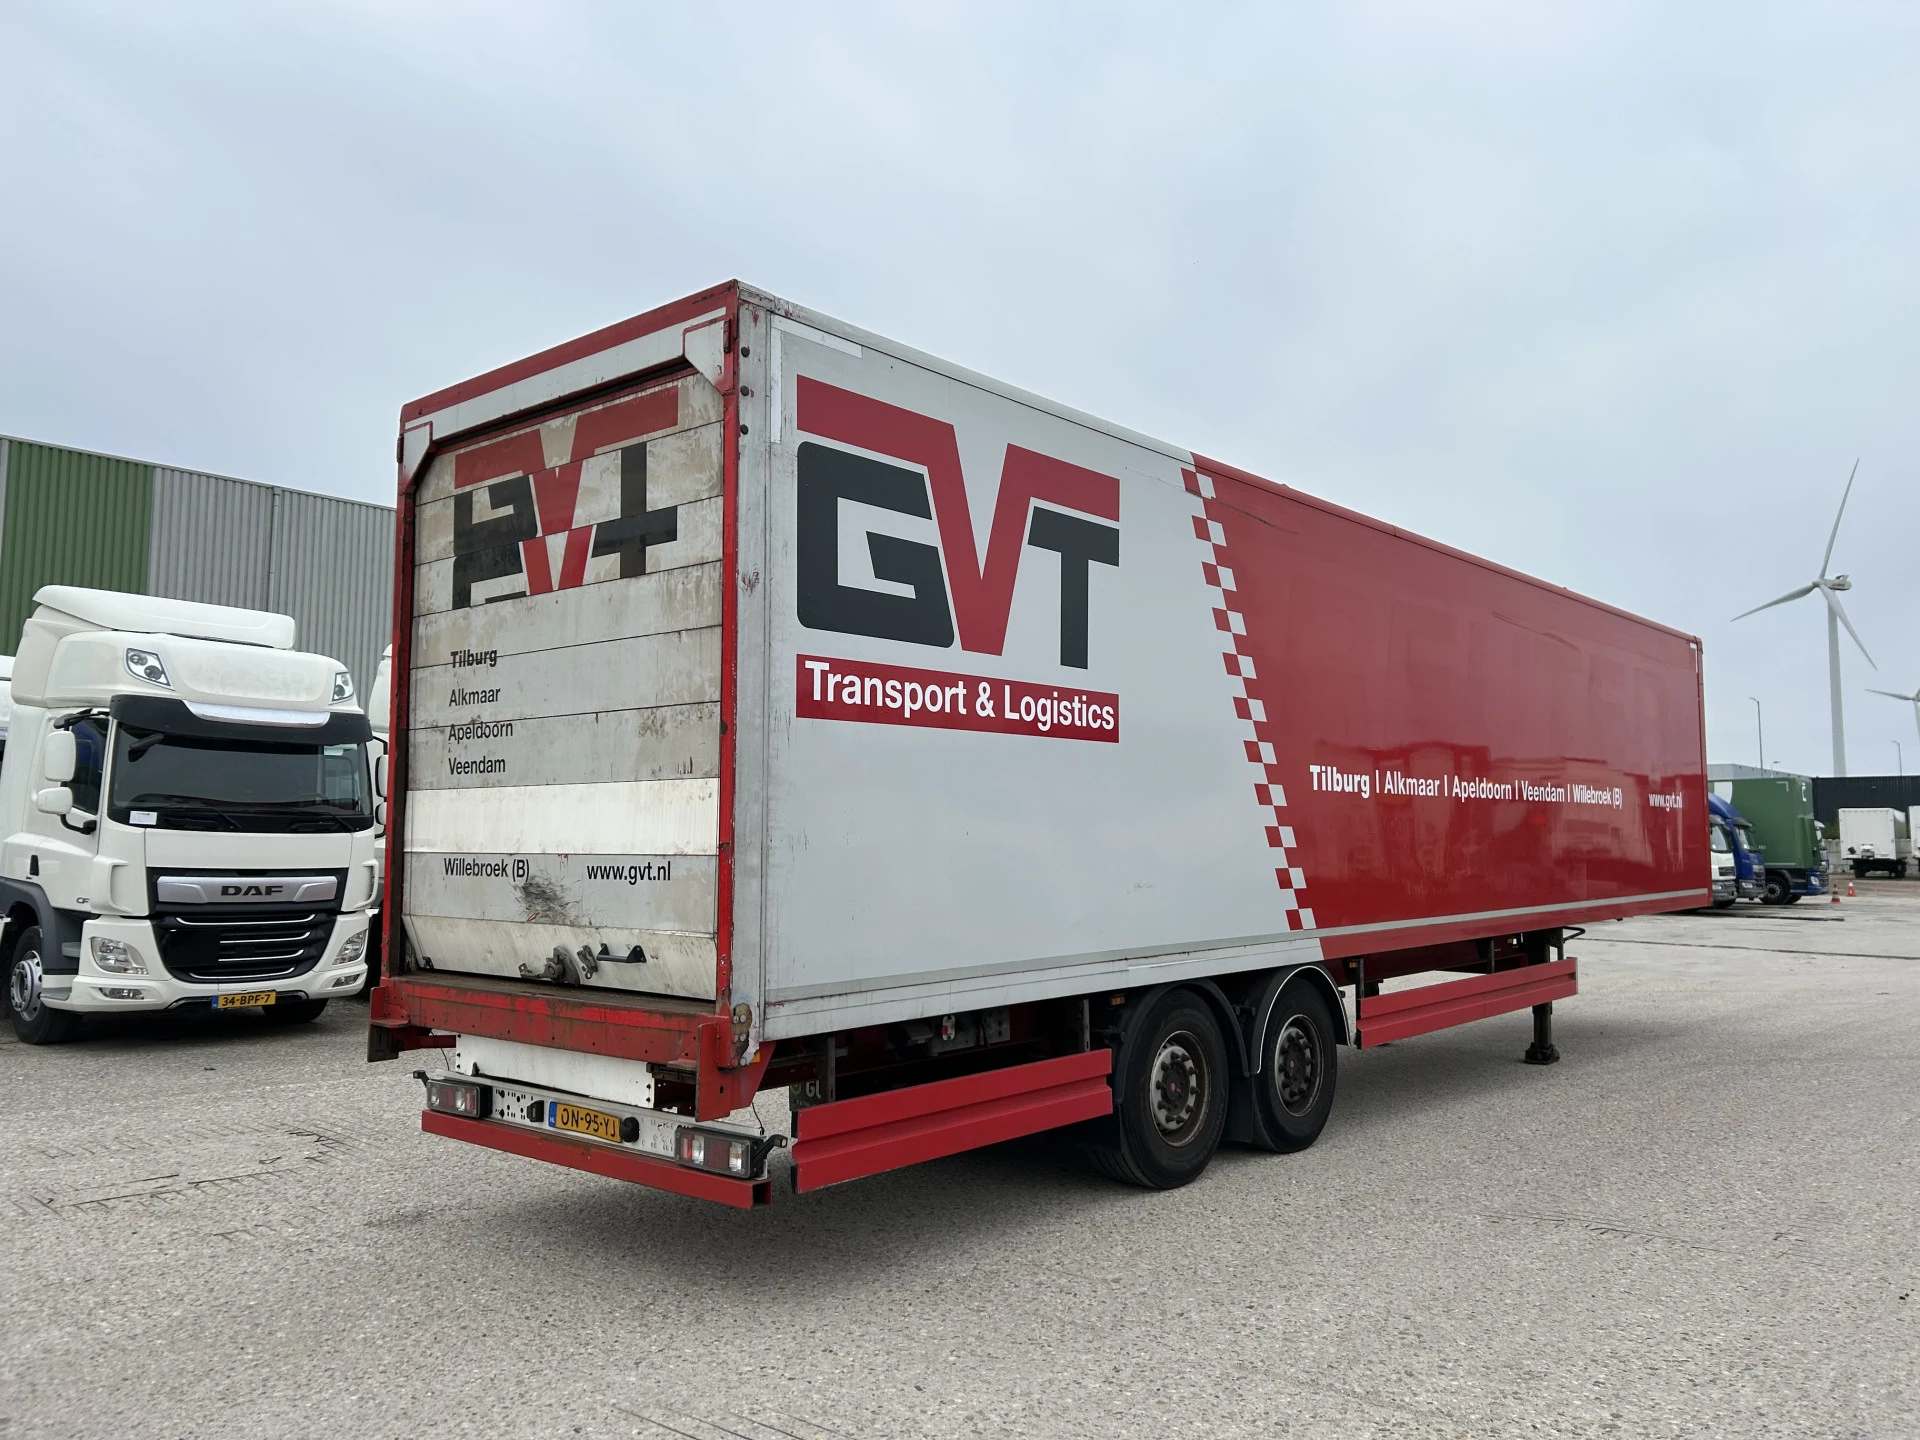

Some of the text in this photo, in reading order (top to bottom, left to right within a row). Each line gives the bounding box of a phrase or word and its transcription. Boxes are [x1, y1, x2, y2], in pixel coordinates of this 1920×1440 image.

[796, 374, 1120, 670] GVT
[450, 649, 498, 668] Tilburg
[448, 687, 501, 707] Alkmaar
[804, 660, 1115, 732] Transport & Logistics
[448, 720, 514, 745] Apeldoorn
[448, 755, 506, 775] Veendam
[1309, 764, 1370, 799] Tilburg
[1384, 770, 1441, 797] Alkmaar
[1452, 775, 1512, 803] Apeldoorn
[1521, 780, 1565, 803] Veendam
[1572, 785, 1611, 806] Willebroek
[1612, 787, 1623, 810] (B)
[1648, 791, 1683, 812] www.gvt.nl
[443, 857, 530, 883] Willebroek (B)
[586, 860, 671, 886] www.gvt.nl
[220, 885, 284, 896] DAF
[221, 993, 271, 1007] 34-BPF-7
[560, 1107, 616, 1138] ON-95-YJ
